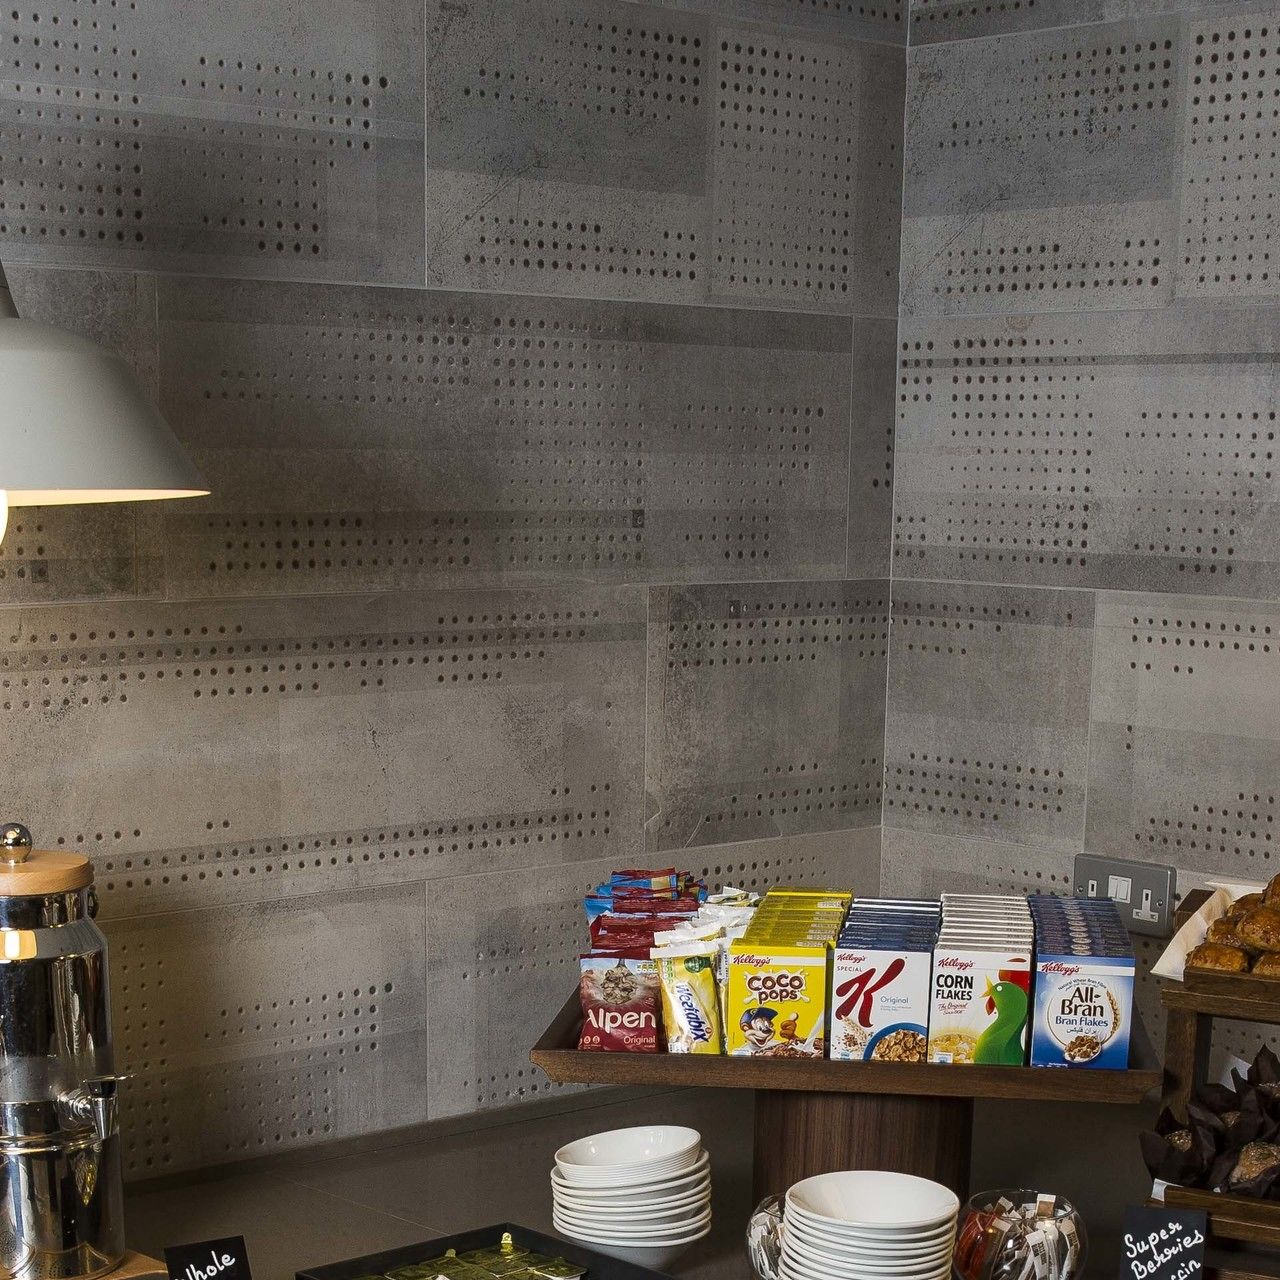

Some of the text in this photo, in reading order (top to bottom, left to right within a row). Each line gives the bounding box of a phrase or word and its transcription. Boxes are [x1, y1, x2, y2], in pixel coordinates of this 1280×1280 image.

[733, 954, 771, 967] Kellogg's
[837, 953, 866, 963] Kellogg's
[938, 958, 974, 970] Kellogg's
[1041, 961, 1080, 975] Kellogg's
[936, 974, 974, 989] CORN
[835, 958, 905, 1028] K
[936, 989, 972, 1001] FLAKES
[880, 996, 909, 1004] Original
[1061, 999, 1104, 1017] Bran
[588, 1008, 657, 1034] Alpen
[1055, 1016, 1109, 1027] Bran Flakes
[623, 1035, 656, 1045] Original
[1124, 1222, 1183, 1260] Super
